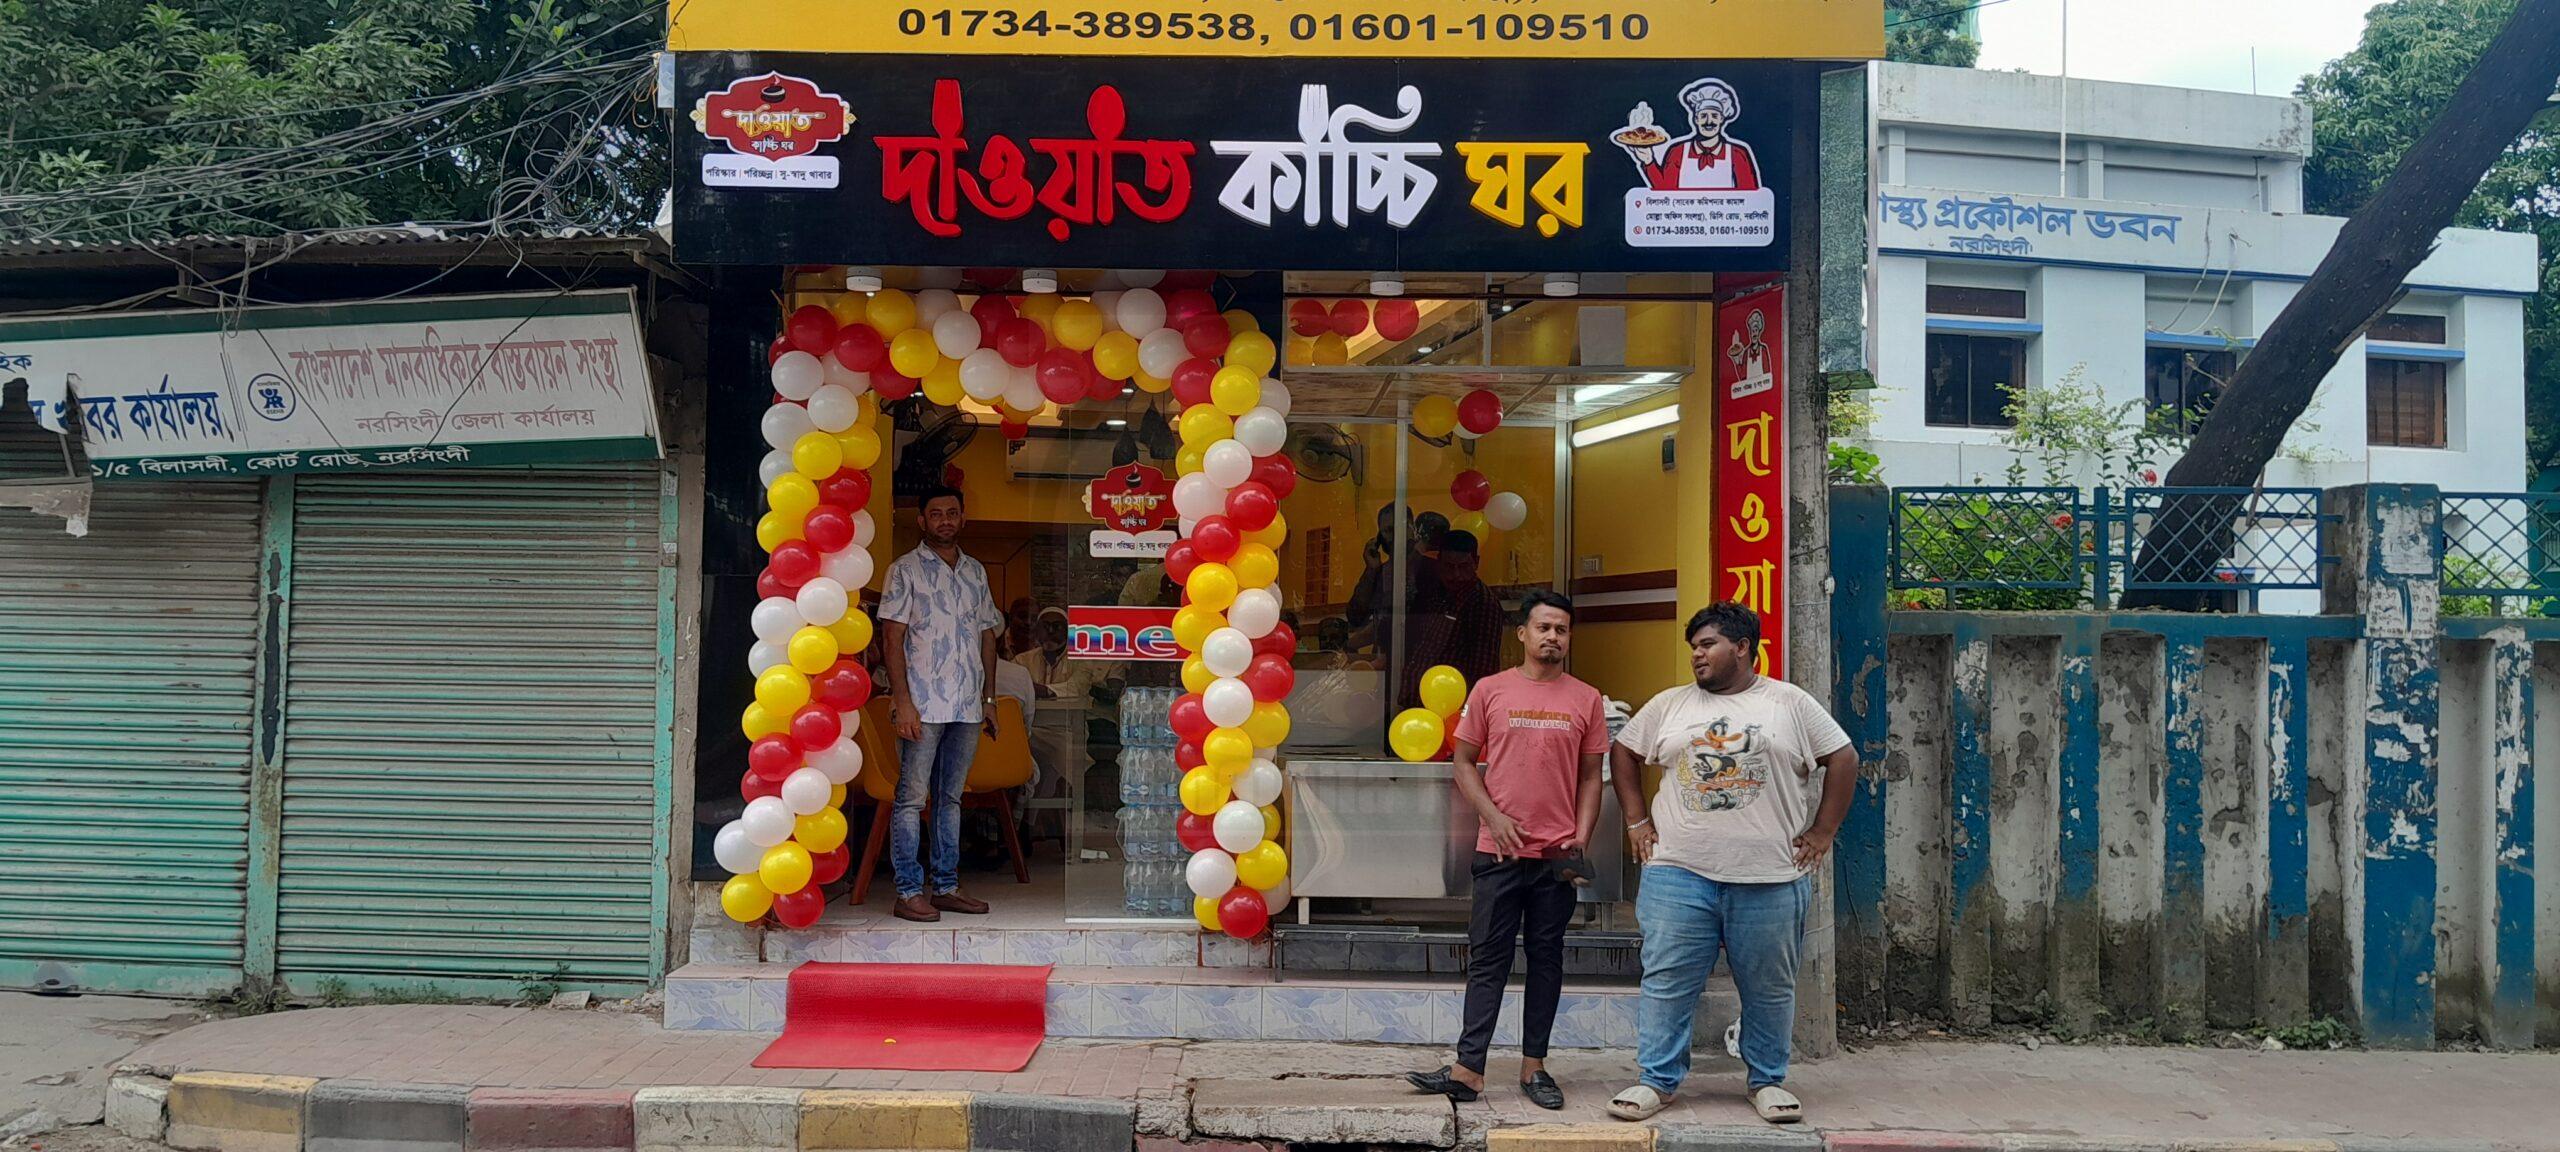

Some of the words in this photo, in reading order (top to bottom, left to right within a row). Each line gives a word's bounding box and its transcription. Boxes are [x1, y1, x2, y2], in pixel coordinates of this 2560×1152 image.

[899, 8, 1270, 45] 01734-389538,
[1289, 13, 1649, 41] 01601-109510
[722, 103, 826, 138] দাওয়াত
[780, 141, 795, 151] ঘর
[873, 79, 1196, 241] দাওয়াত
[1209, 84, 1443, 228] কাচ্চি
[1454, 141, 1591, 237] ঘর
[809, 171, 832, 180] খাবার
[1646, 226, 1707, 236] 01734-389538,
[1709, 226, 1769, 235] 01601-109510
[1934, 195, 2078, 236] প্রকৌশল
[2083, 210, 2183, 245] ভবন
[288, 342, 379, 407] বাংলাদেশ
[376, 326, 488, 399] মানবাধিকার
[485, 334, 573, 395] বাস্তবায়ন
[569, 330, 625, 402] সংস্থা
[355, 408, 442, 434] নরসিংদী
[451, 411, 505, 430] জেলা
[510, 404, 597, 429] কার্যালয়
[138, 456, 238, 475] বিলাসদী,
[247, 451, 300, 470] কোর্ট
[374, 445, 471, 465] নরসিংদী
